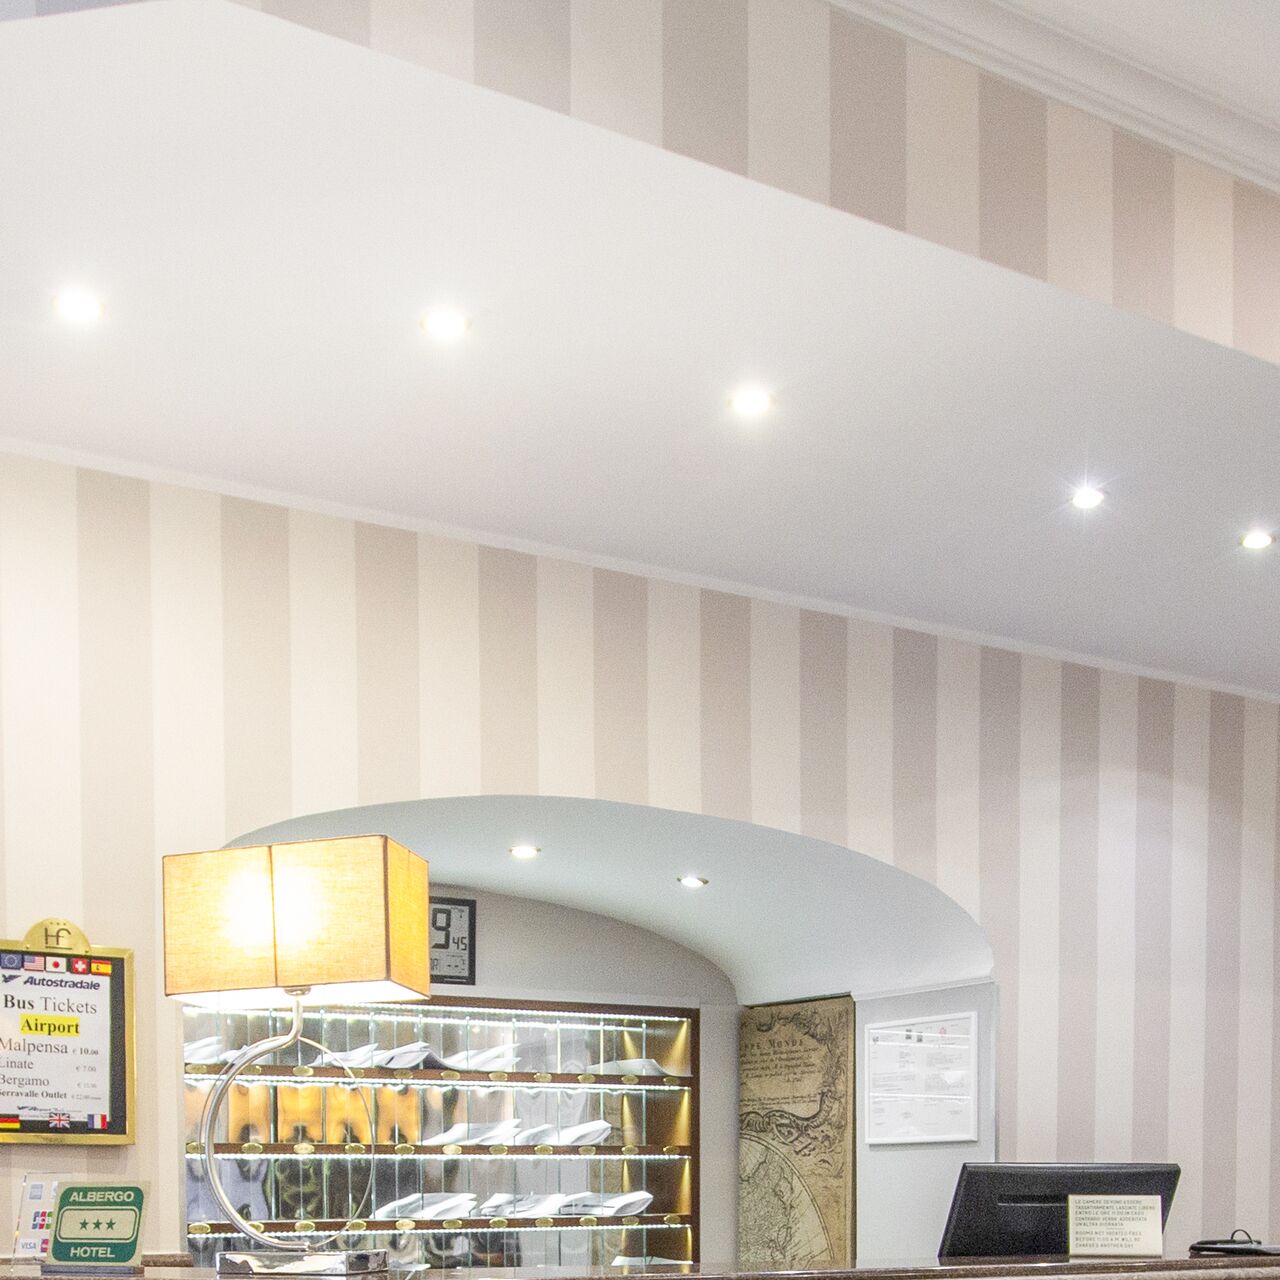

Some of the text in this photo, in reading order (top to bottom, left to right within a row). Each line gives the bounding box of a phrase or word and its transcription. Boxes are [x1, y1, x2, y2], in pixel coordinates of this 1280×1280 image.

[452, 936, 467, 951] 45
[23, 975, 101, 991] Autostradale
[3, 994, 97, 1014] Bus Tickets
[21, 1018, 80, 1036] Airport
[41, 1090, 67, 1099] Outlet
[69, 1191, 135, 1202] ALBERGO
[21, 1242, 37, 1250] VISA
[70, 1246, 116, 1258] HOTEL
